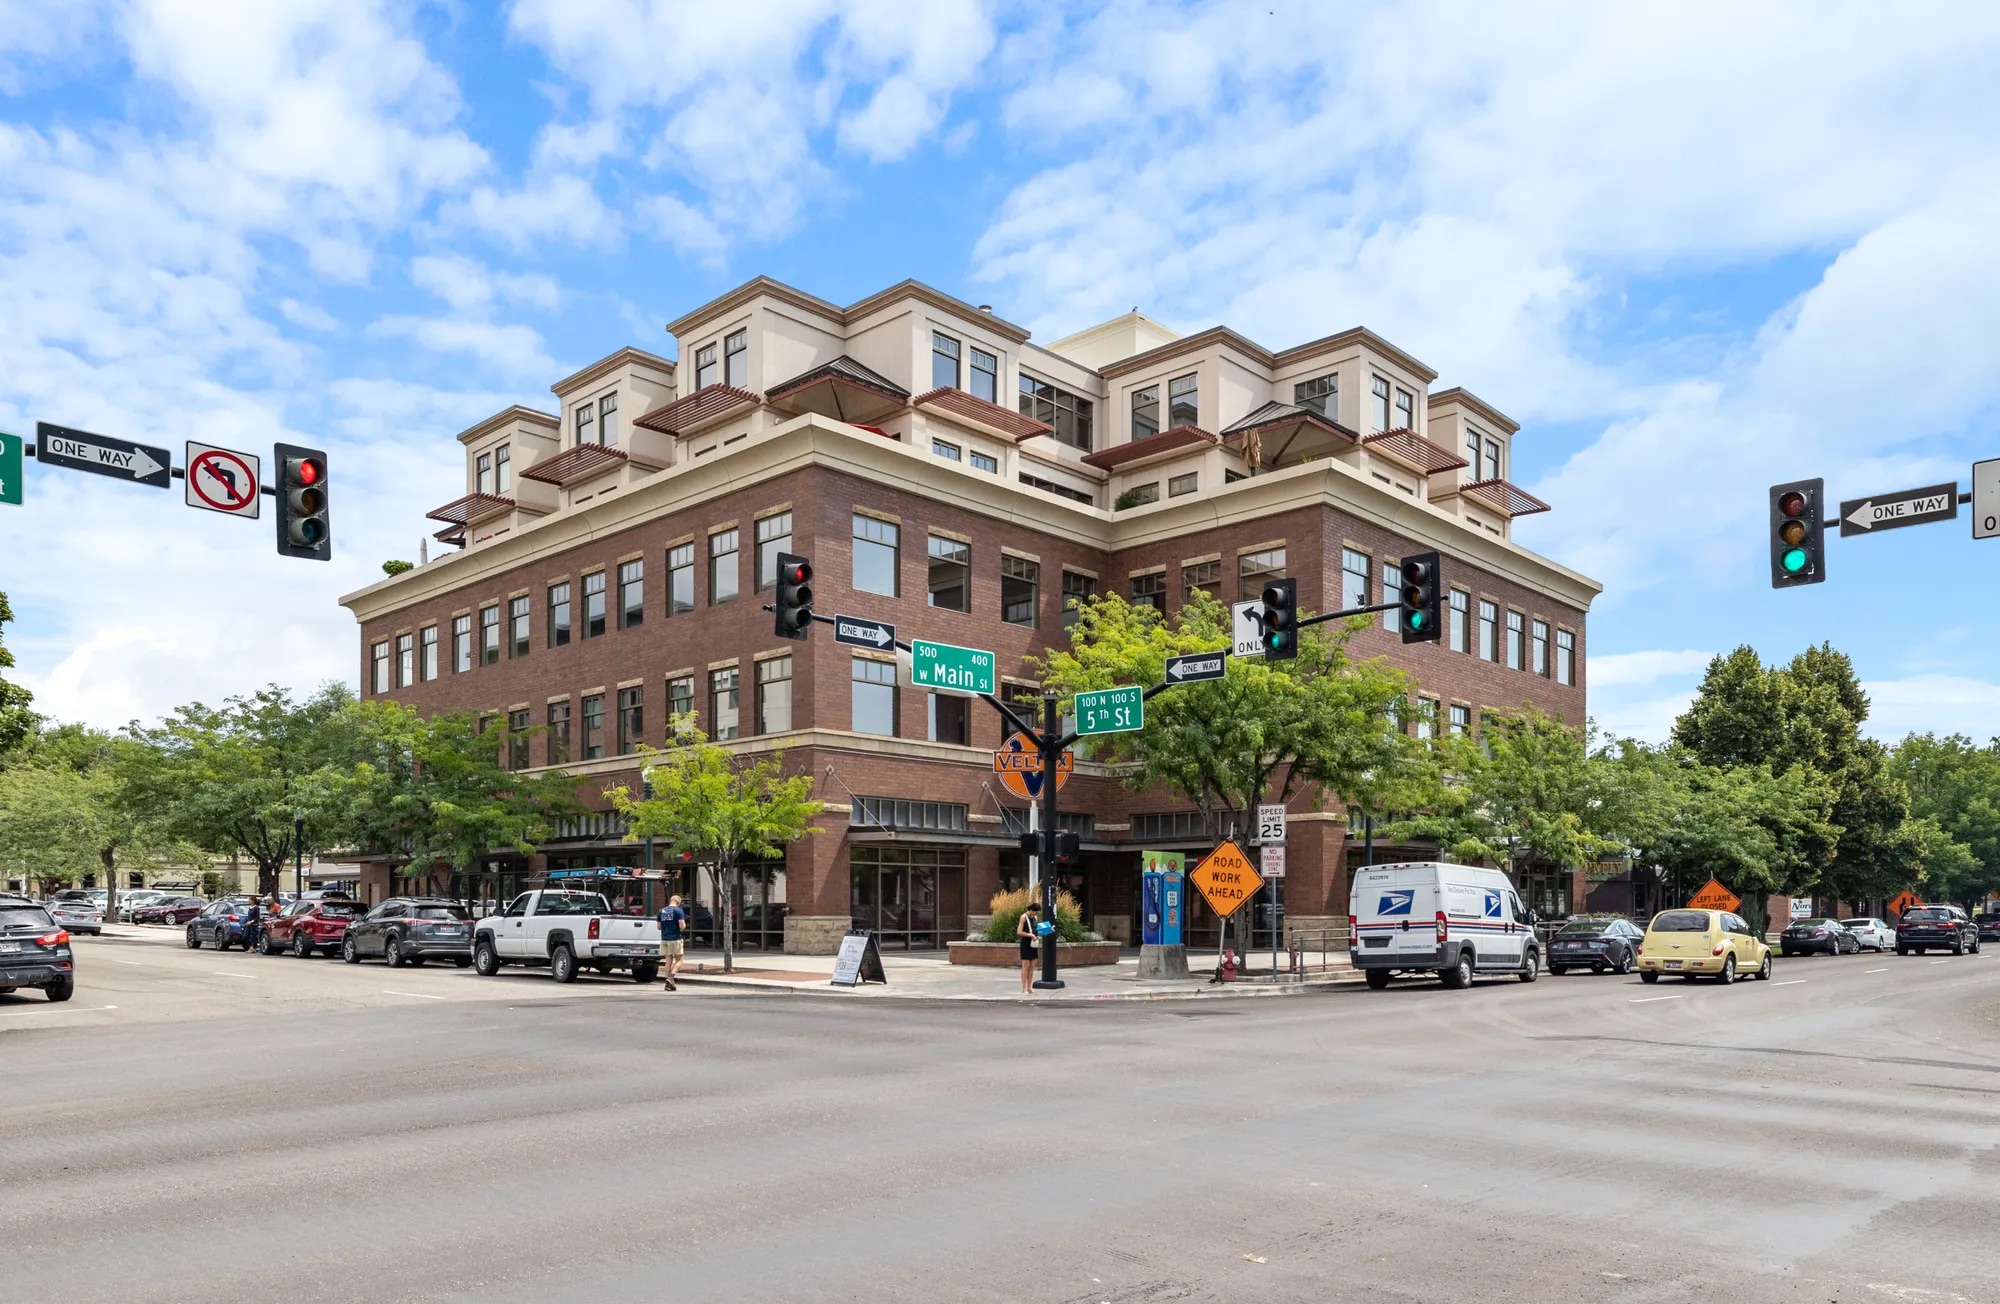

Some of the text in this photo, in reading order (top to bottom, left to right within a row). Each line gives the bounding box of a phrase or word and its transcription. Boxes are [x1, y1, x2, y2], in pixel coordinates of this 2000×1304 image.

[52, 438, 133, 467] ONE WAY
[1874, 496, 1945, 519] ONE WAY
[841, 624, 878, 639] ONE WAY
[919, 645, 988, 666] 500 400
[1182, 660, 1219, 674] ONE WAY
[934, 662, 974, 687] Main
[979, 678, 988, 689] St
[1081, 691, 1136, 707] 100 N 100 S
[1087, 706, 1131, 729] 5 Th St
[997, 752, 1069, 770] VELTX
[1261, 823, 1283, 838] 25
[1213, 856, 1242, 869] ROAD
[1212, 871, 1241, 885] WORK
[1207, 886, 1243, 900] AHEAD
[1696, 894, 1731, 903] LEFT LANE
